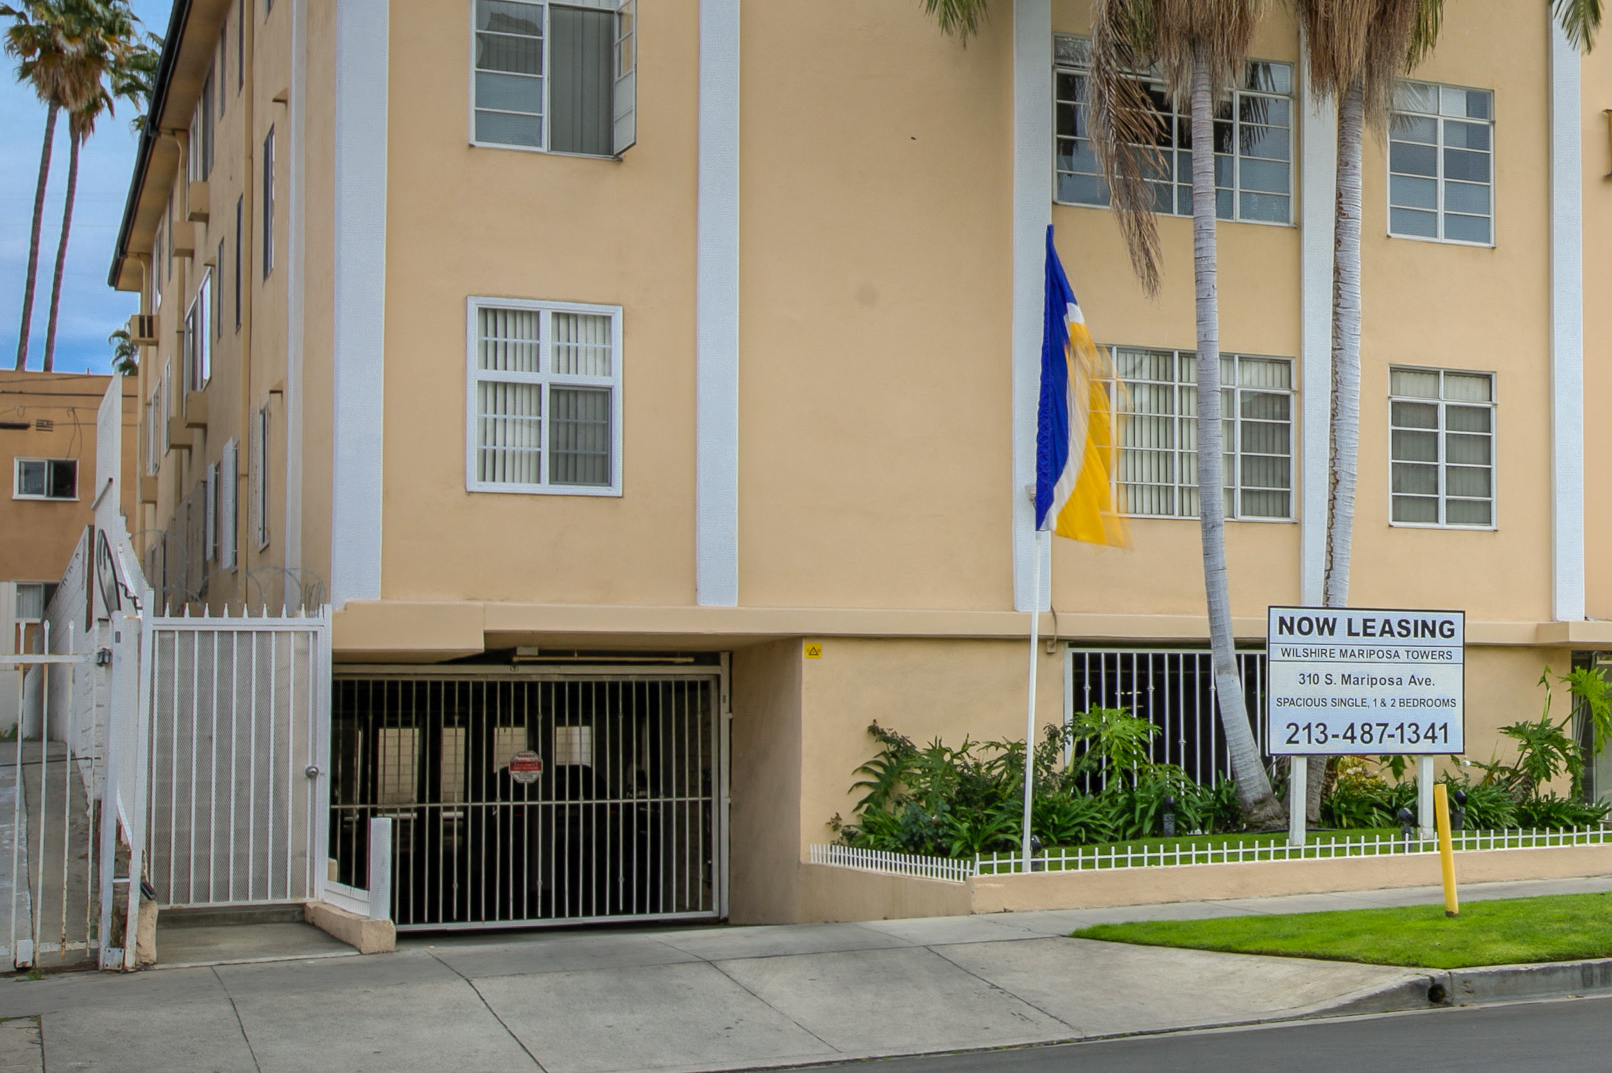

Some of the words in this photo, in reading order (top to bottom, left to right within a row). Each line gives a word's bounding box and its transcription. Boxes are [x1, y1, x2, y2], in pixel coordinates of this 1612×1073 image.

[1278, 615, 1337, 637] NOW
[1346, 617, 1455, 639] LEASING
[1280, 647, 1336, 659] WILSHIRE
[1339, 649, 1401, 660] MARIPOSA
[1405, 650, 1453, 661] TOWERS
[1298, 673, 1320, 686] 310
[1325, 674, 1337, 686] S.
[1341, 674, 1403, 689] Mariposa
[1408, 675, 1436, 687] Ave.
[1276, 697, 1328, 708] SPACIOUS
[1330, 698, 1370, 709] SINGLE,
[1372, 698, 1378, 708] 1
[1379, 698, 1387, 708] &
[1390, 699, 1396, 708] 2
[1398, 698, 1457, 709] BEDROOMS
[1285, 722, 1449, 745] 213-487-1341
